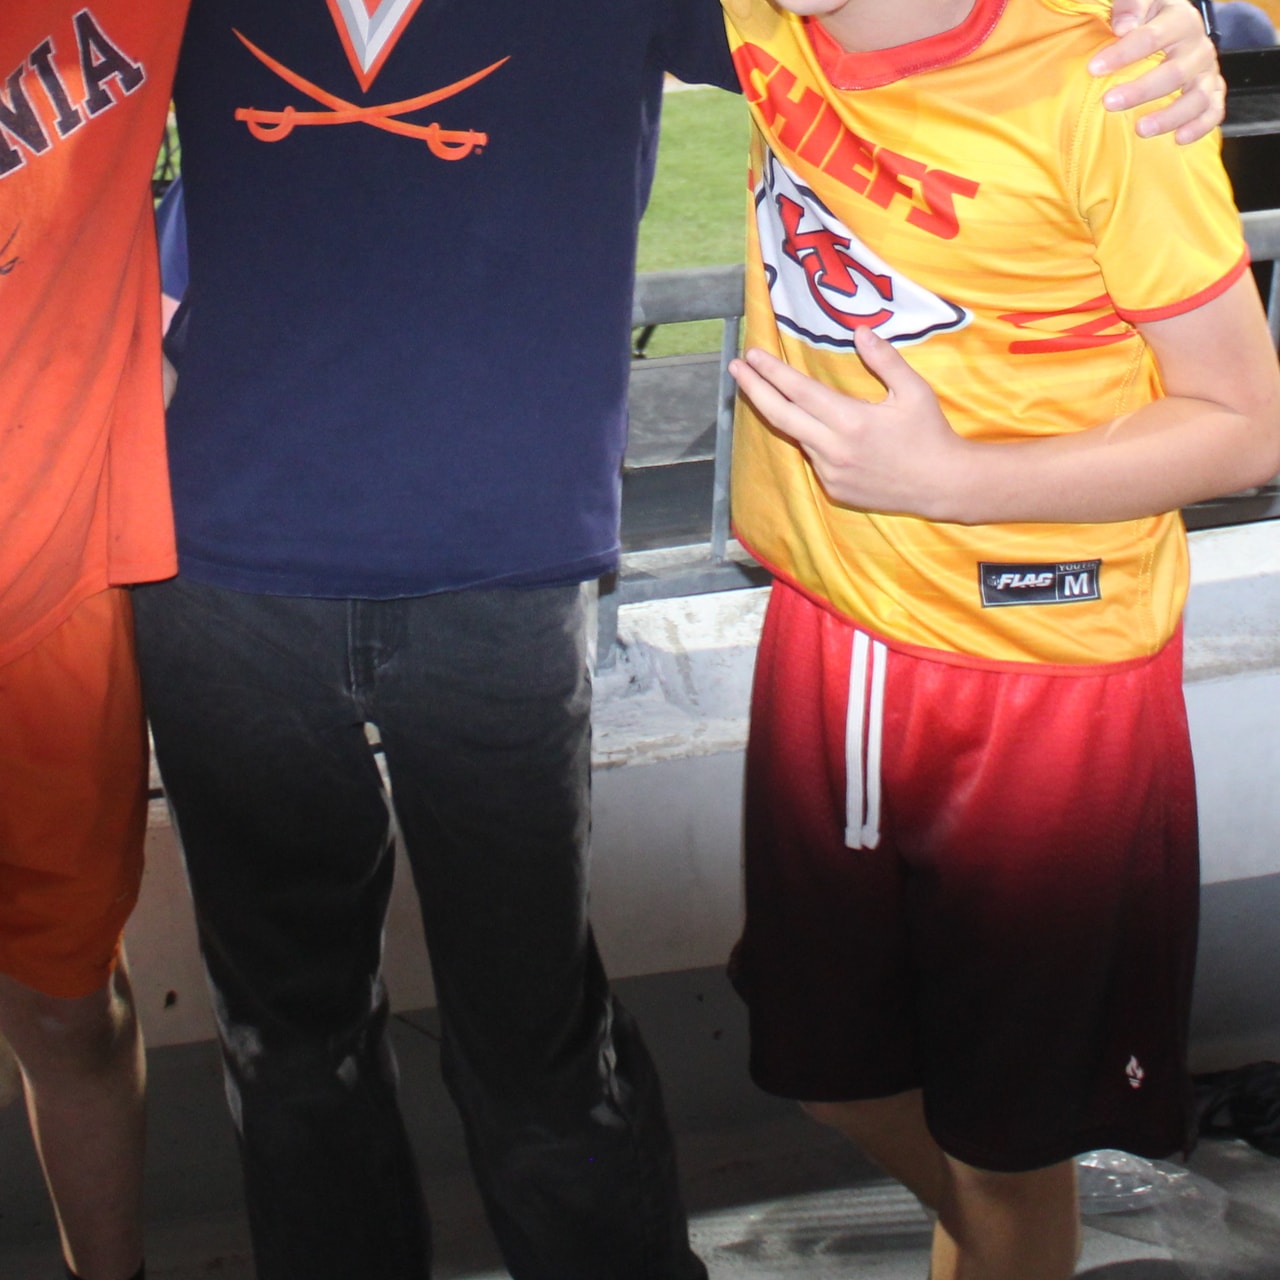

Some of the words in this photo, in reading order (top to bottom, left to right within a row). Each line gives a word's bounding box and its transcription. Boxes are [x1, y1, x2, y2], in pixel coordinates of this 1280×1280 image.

[730, 40, 980, 241] CHIEFS
[996, 572, 1054, 590] FLAG
[1063, 572, 1090, 597] M
